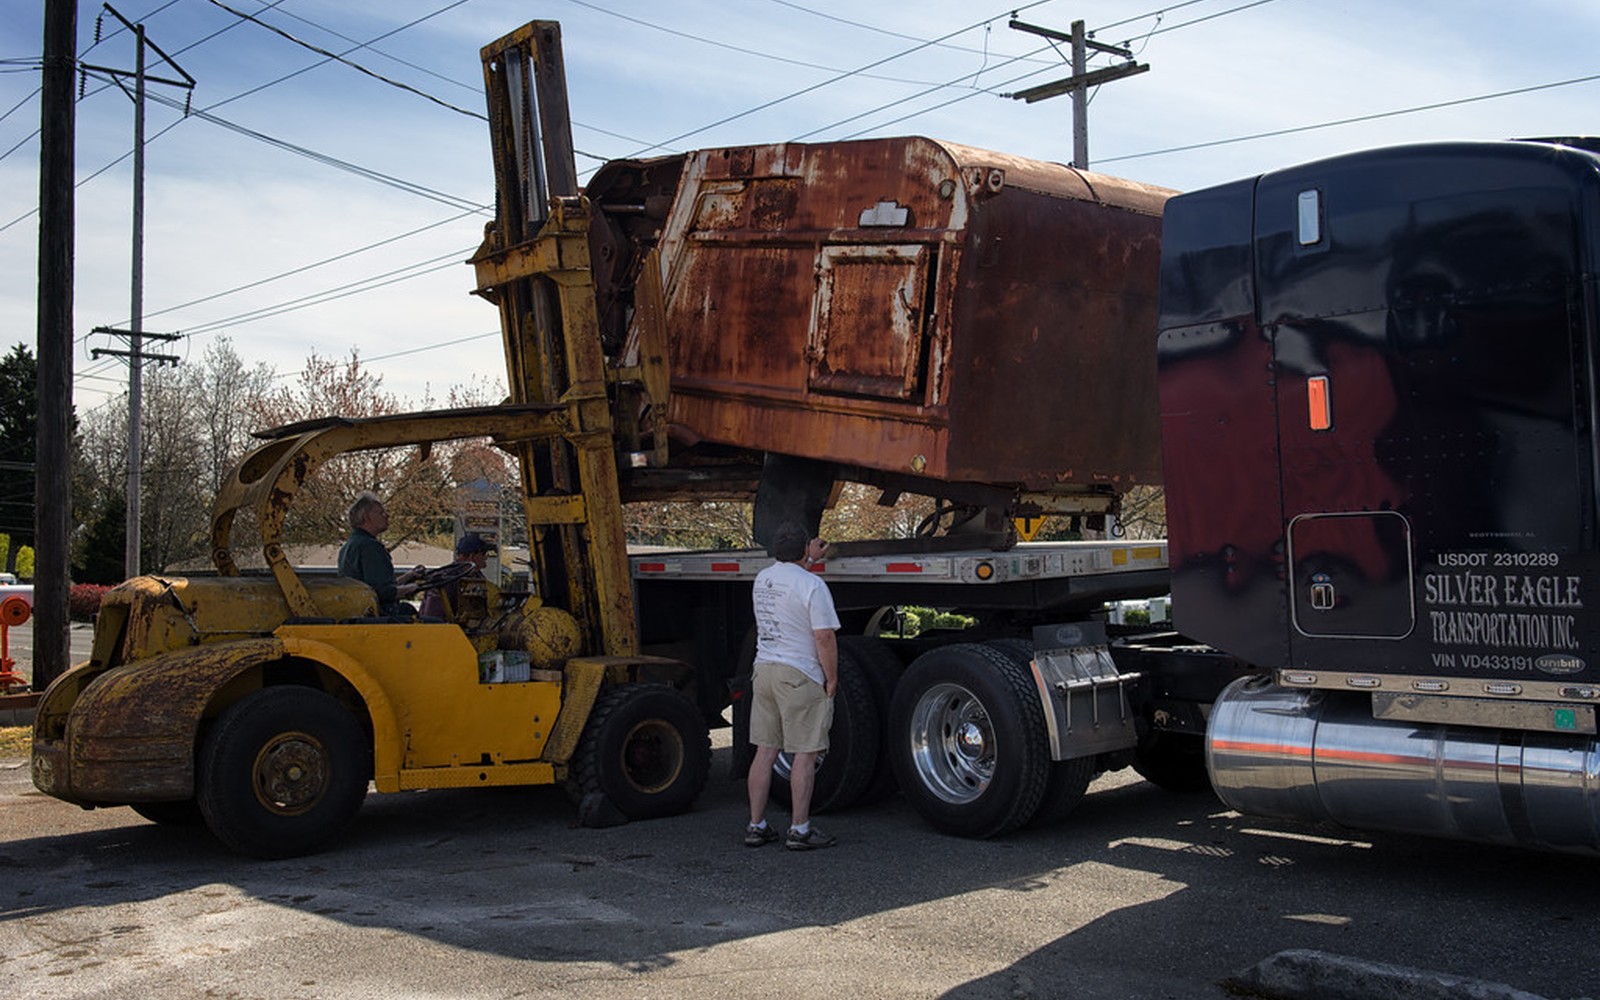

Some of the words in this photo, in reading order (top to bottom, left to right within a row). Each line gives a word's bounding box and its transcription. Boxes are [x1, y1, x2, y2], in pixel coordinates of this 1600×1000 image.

[1438, 553, 1487, 566] USDOT
[1494, 553, 1559, 566] 2310289
[1425, 569, 1498, 607] SILVER
[1504, 576, 1583, 607] EAGLE
[1430, 611, 1549, 648] TRANSPORTATION
[1552, 615, 1580, 649] INC.
[1432, 654, 1456, 668] VIN
[1461, 655, 1533, 670] VD433191
